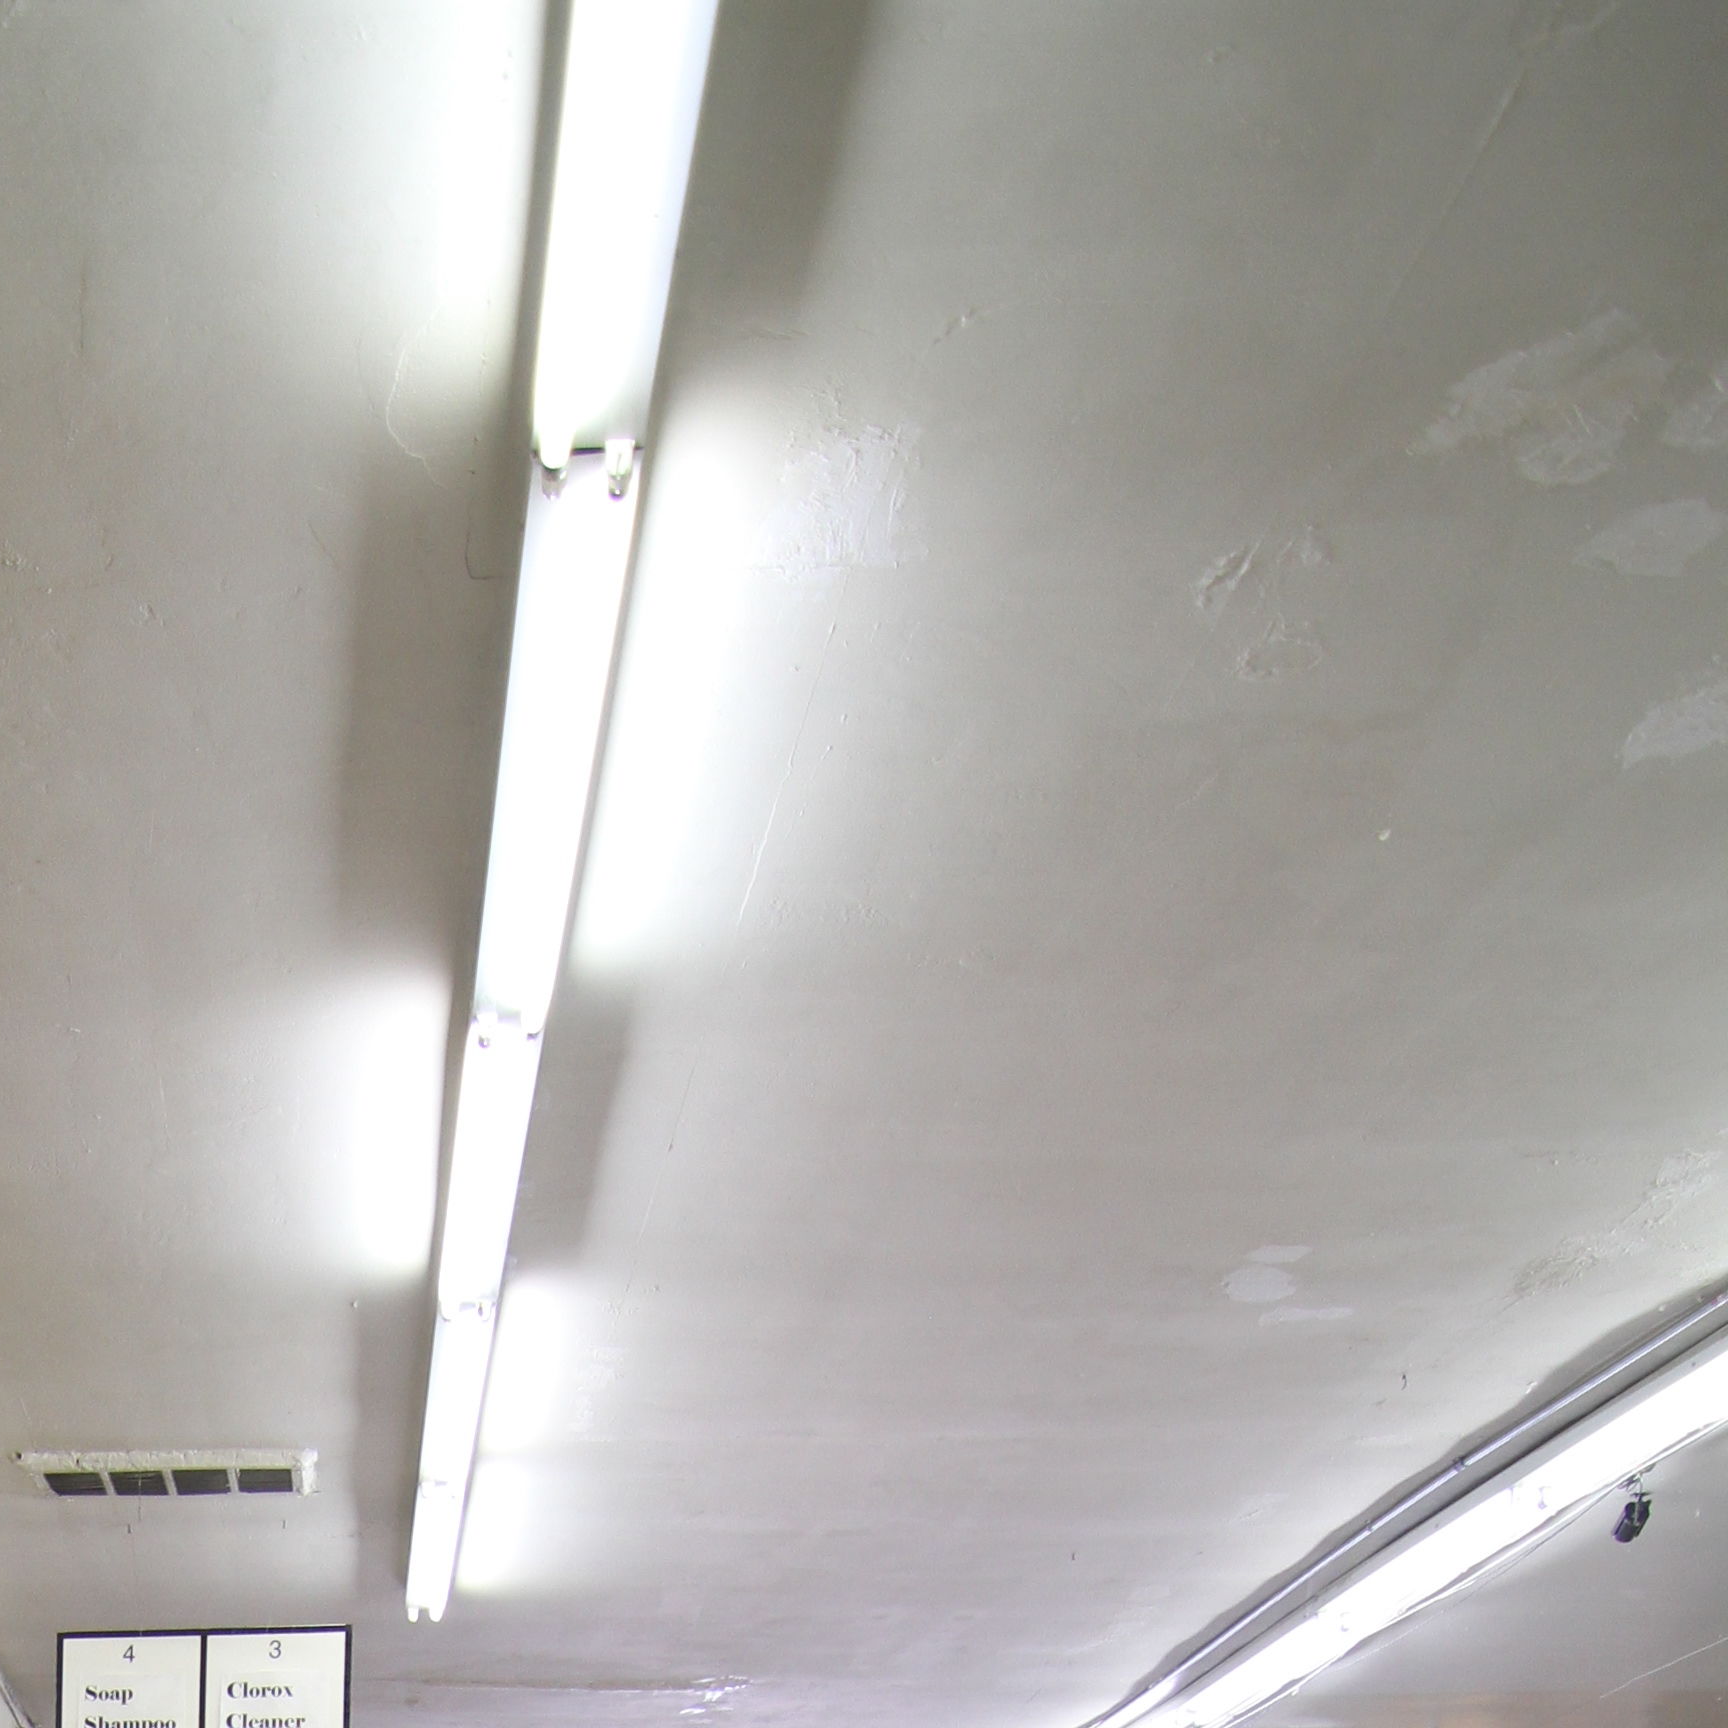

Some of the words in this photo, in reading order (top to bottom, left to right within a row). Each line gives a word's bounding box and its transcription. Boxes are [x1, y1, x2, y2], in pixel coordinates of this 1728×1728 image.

[122, 1645, 135, 1663] 4
[268, 1640, 282, 1659] 3
[84, 1685, 134, 1705] Soap
[227, 1681, 294, 1699] Clorox
